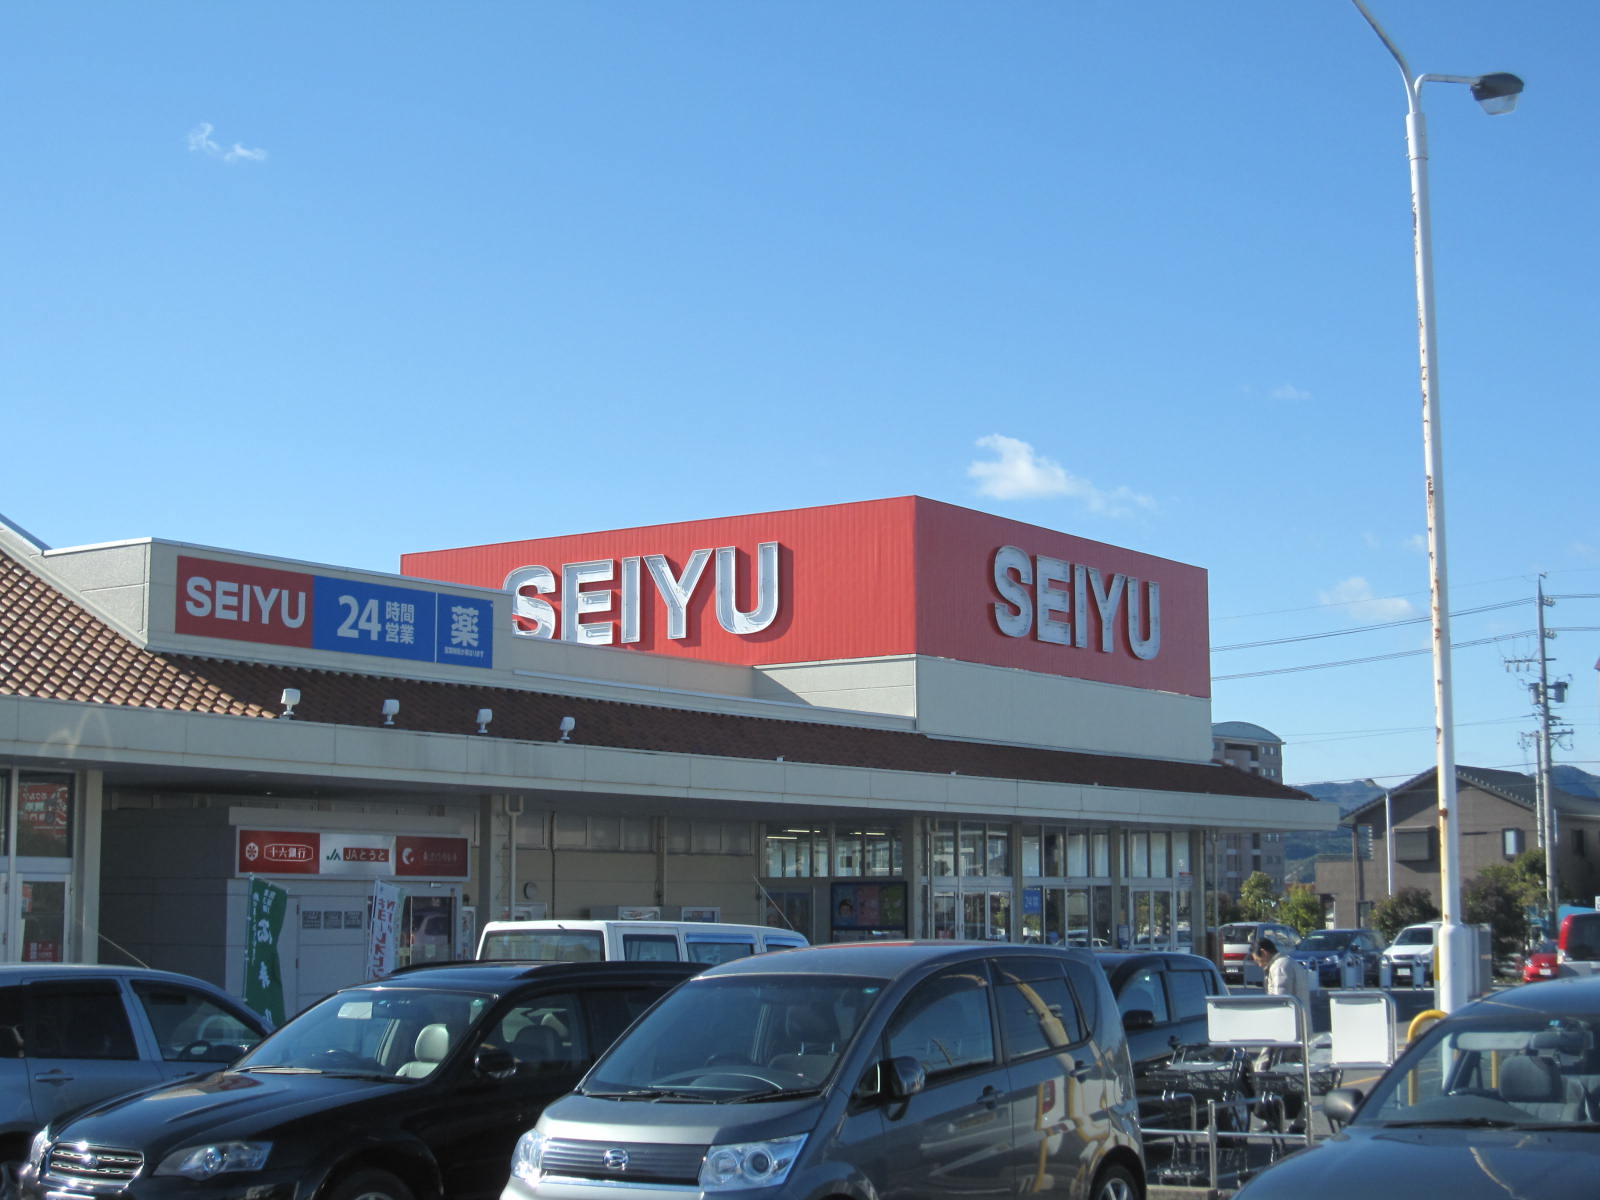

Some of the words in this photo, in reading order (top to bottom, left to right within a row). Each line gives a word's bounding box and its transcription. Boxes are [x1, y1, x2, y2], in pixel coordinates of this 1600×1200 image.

[185, 576, 306, 629] SEIYU
[503, 541, 778, 645] SEIYU
[994, 545, 1161, 660] SEIYU
[336, 594, 382, 641] 24
[385, 600, 415, 623] 時間
[385, 621, 415, 646] 営業
[451, 605, 480, 647] 薬
[269, 846, 307, 858] 十六銀行
